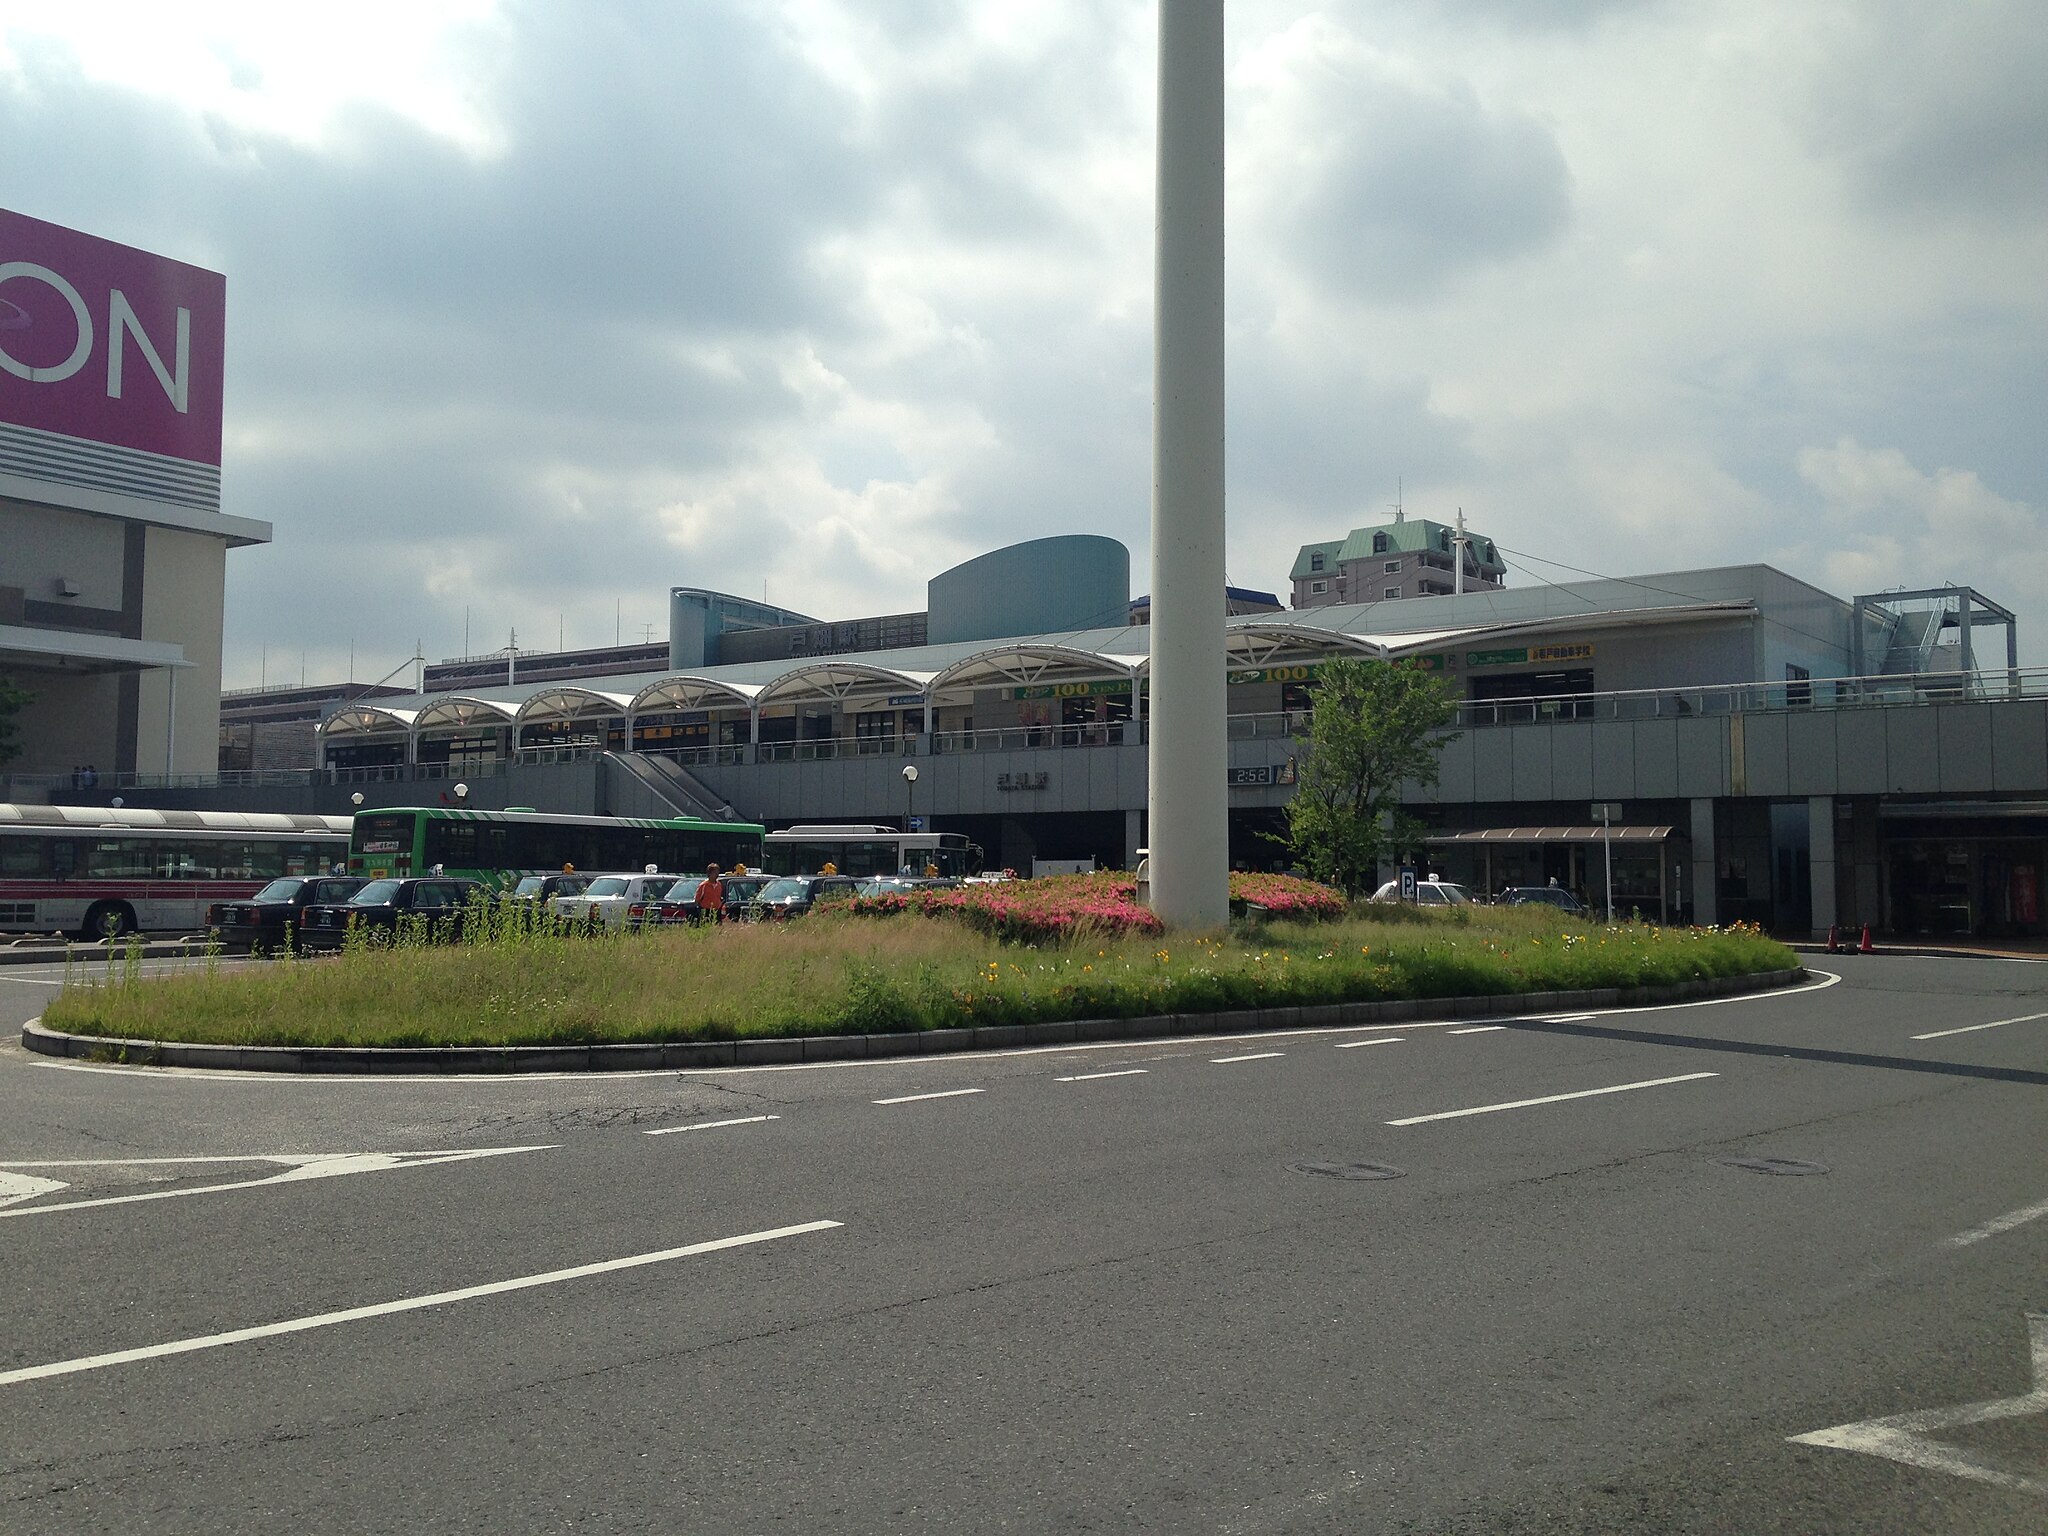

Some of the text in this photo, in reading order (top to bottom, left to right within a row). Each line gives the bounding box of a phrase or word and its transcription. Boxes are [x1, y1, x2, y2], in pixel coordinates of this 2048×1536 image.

[1263, 666, 1308, 682] 100
[1053, 682, 1090, 697] 100
[1237, 769, 1266, 782] 2:52
